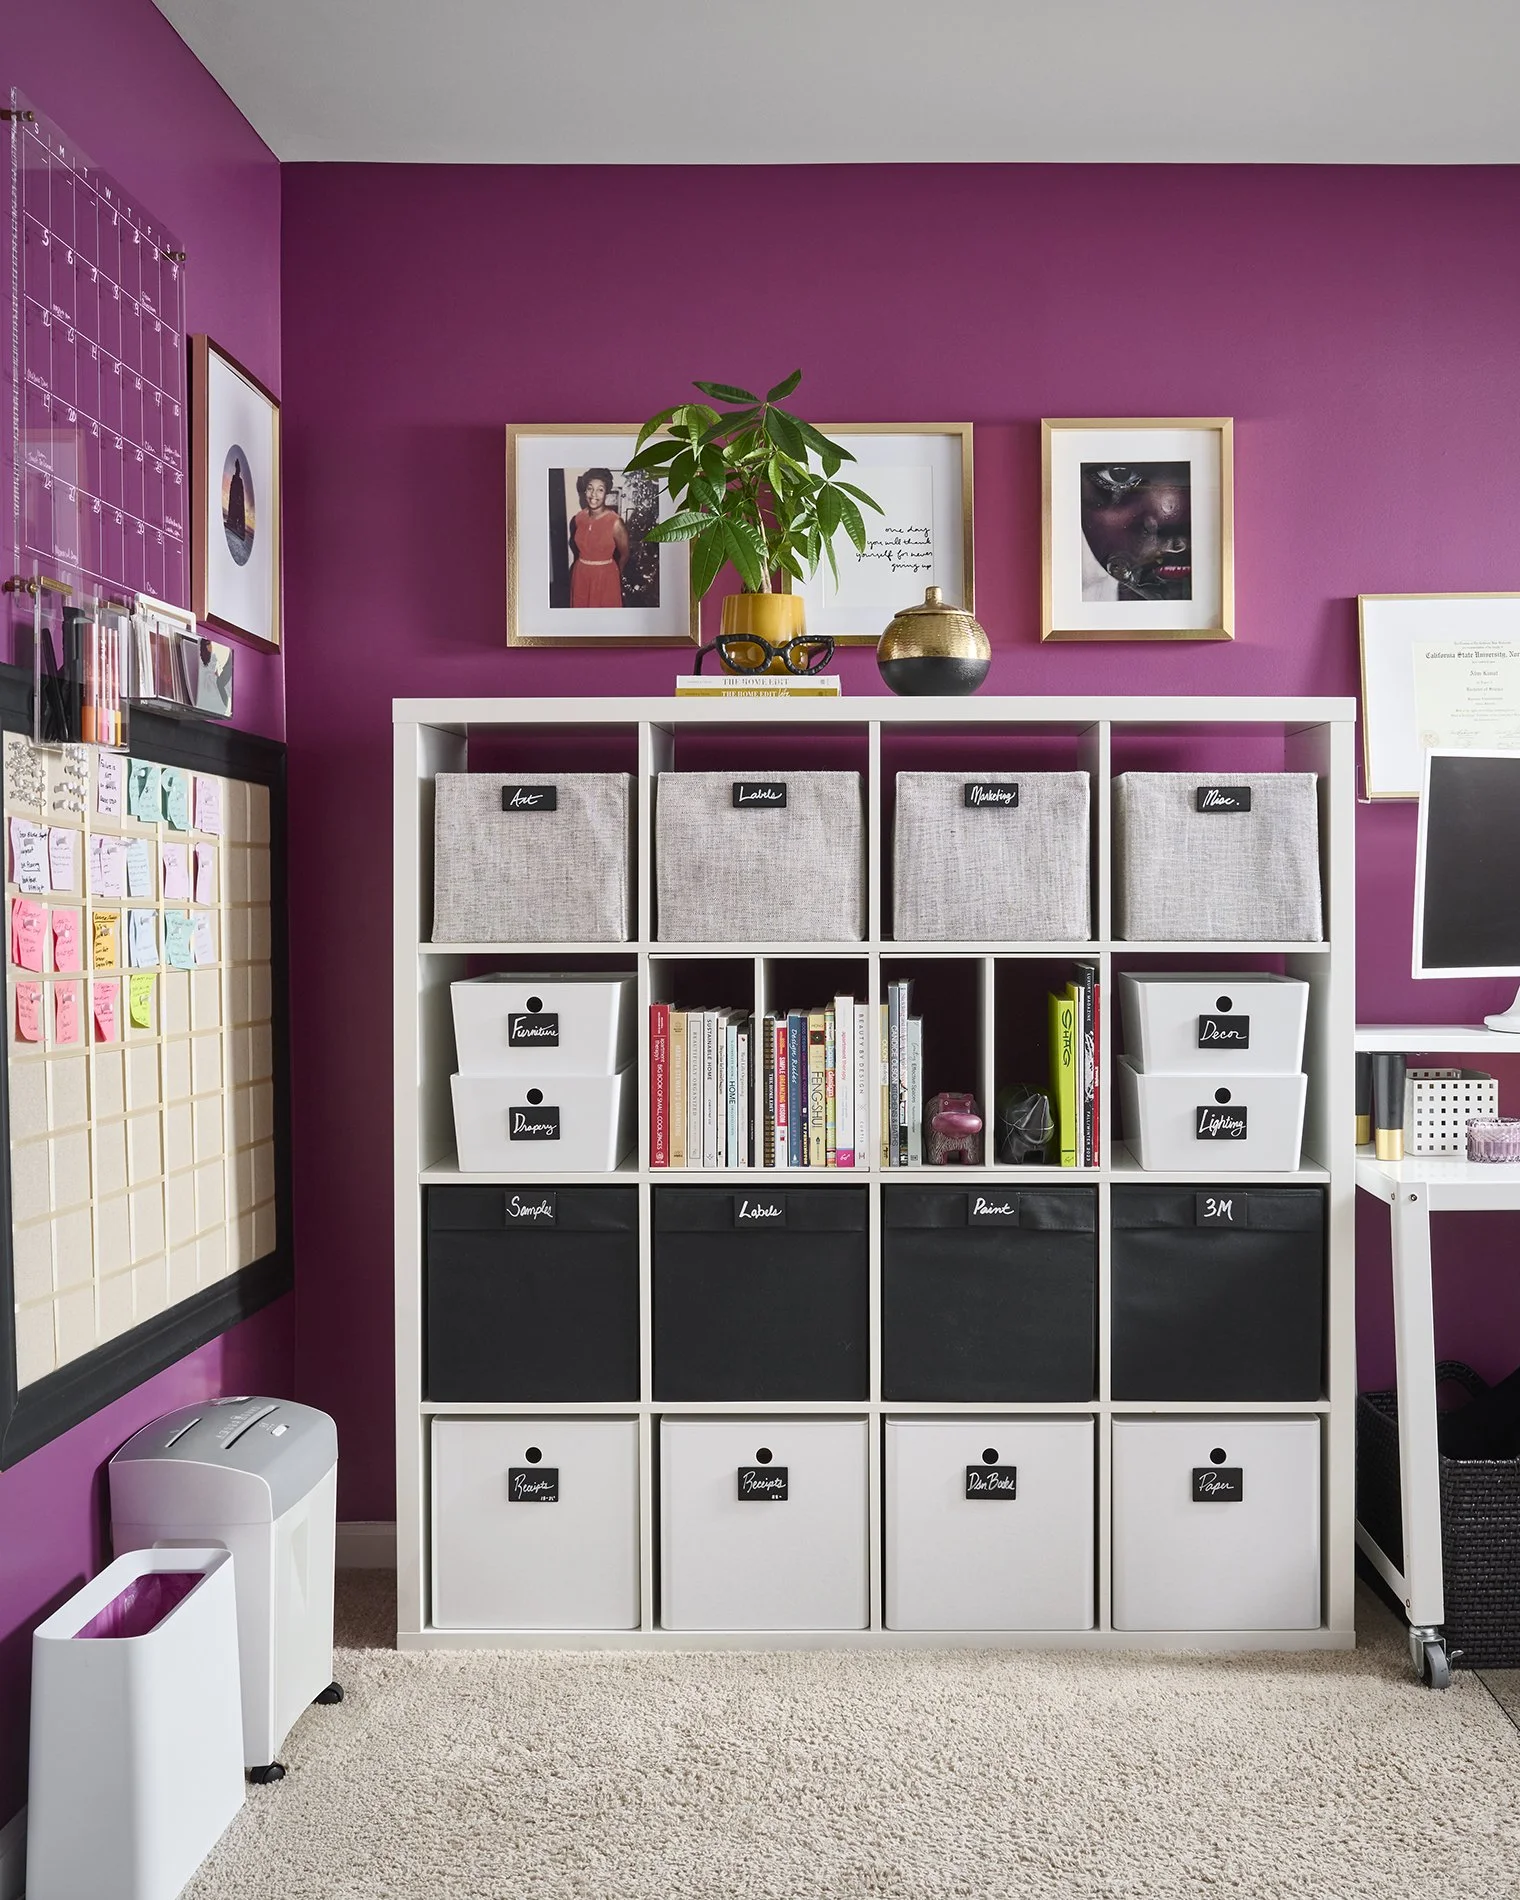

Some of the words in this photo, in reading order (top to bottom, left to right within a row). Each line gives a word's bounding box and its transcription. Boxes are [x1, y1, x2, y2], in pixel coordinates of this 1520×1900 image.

[34, 122, 40, 135] S
[59, 145, 65, 158] M
[83, 167, 88, 178] T
[105, 187, 112, 199] W
[127, 207, 132, 218] T
[147, 226, 152, 236] F
[166, 243, 171, 254] S
[42, 229, 50, 247] 5
[67, 250, 73, 265] 6
[134, 229, 140, 244] 2
[907, 525, 931, 538] day
[867, 540, 884, 550] you
[885, 537, 902, 546] will
[903, 537, 932, 545] thank
[856, 549, 893, 562] yourself
[897, 549, 909, 560] for
[891, 563, 920, 573] giving
[1425, 651, 1456, 659] California
[1474, 650, 1508, 659] University,
[722, 678, 738, 686] THE
[741, 678, 768, 686] HOME
[769, 678, 790, 686] EDIT
[509, 787, 544, 808] Art
[738, 785, 783, 802] Labels
[970, 785, 1016, 804] Marketing
[1202, 789, 1240, 808] Misc.
[511, 1016, 559, 1040] Furniture
[1061, 1009, 1073, 1068] SHAG
[1200, 1020, 1247, 1041] Decor
[790, 1028, 798, 1058] Design
[890, 1025, 898, 1057] CANDICE
[858, 1049, 865, 1060] BY
[656, 1063, 664, 1073] BIG
[791, 1058, 799, 1084] Rules
[890, 1058, 898, 1083] OLSON
[910, 1063, 918, 1085] Effective
[656, 1073, 664, 1090] BOOK
[656, 1089, 664, 1098] OF
[811, 1071, 824, 1128] FENG-SHUI
[890, 1083, 899, 1118] KITCHENS
[513, 1112, 557, 1136] Drapery
[656, 1115, 664, 1131] COOL
[1199, 1109, 1247, 1137] Lighting
[656, 1131, 664, 1150] SPACES
[891, 1124, 899, 1147] BATHS
[738, 1200, 783, 1219] Labels
[973, 1197, 1015, 1216] Paint
[1203, 1198, 1234, 1221] 3M
[514, 1473, 555, 1500] Receipts
[742, 1470, 787, 1494] Receipts
[986, 1472, 1016, 1491] Books
[1199, 1471, 1235, 1495] Paper
